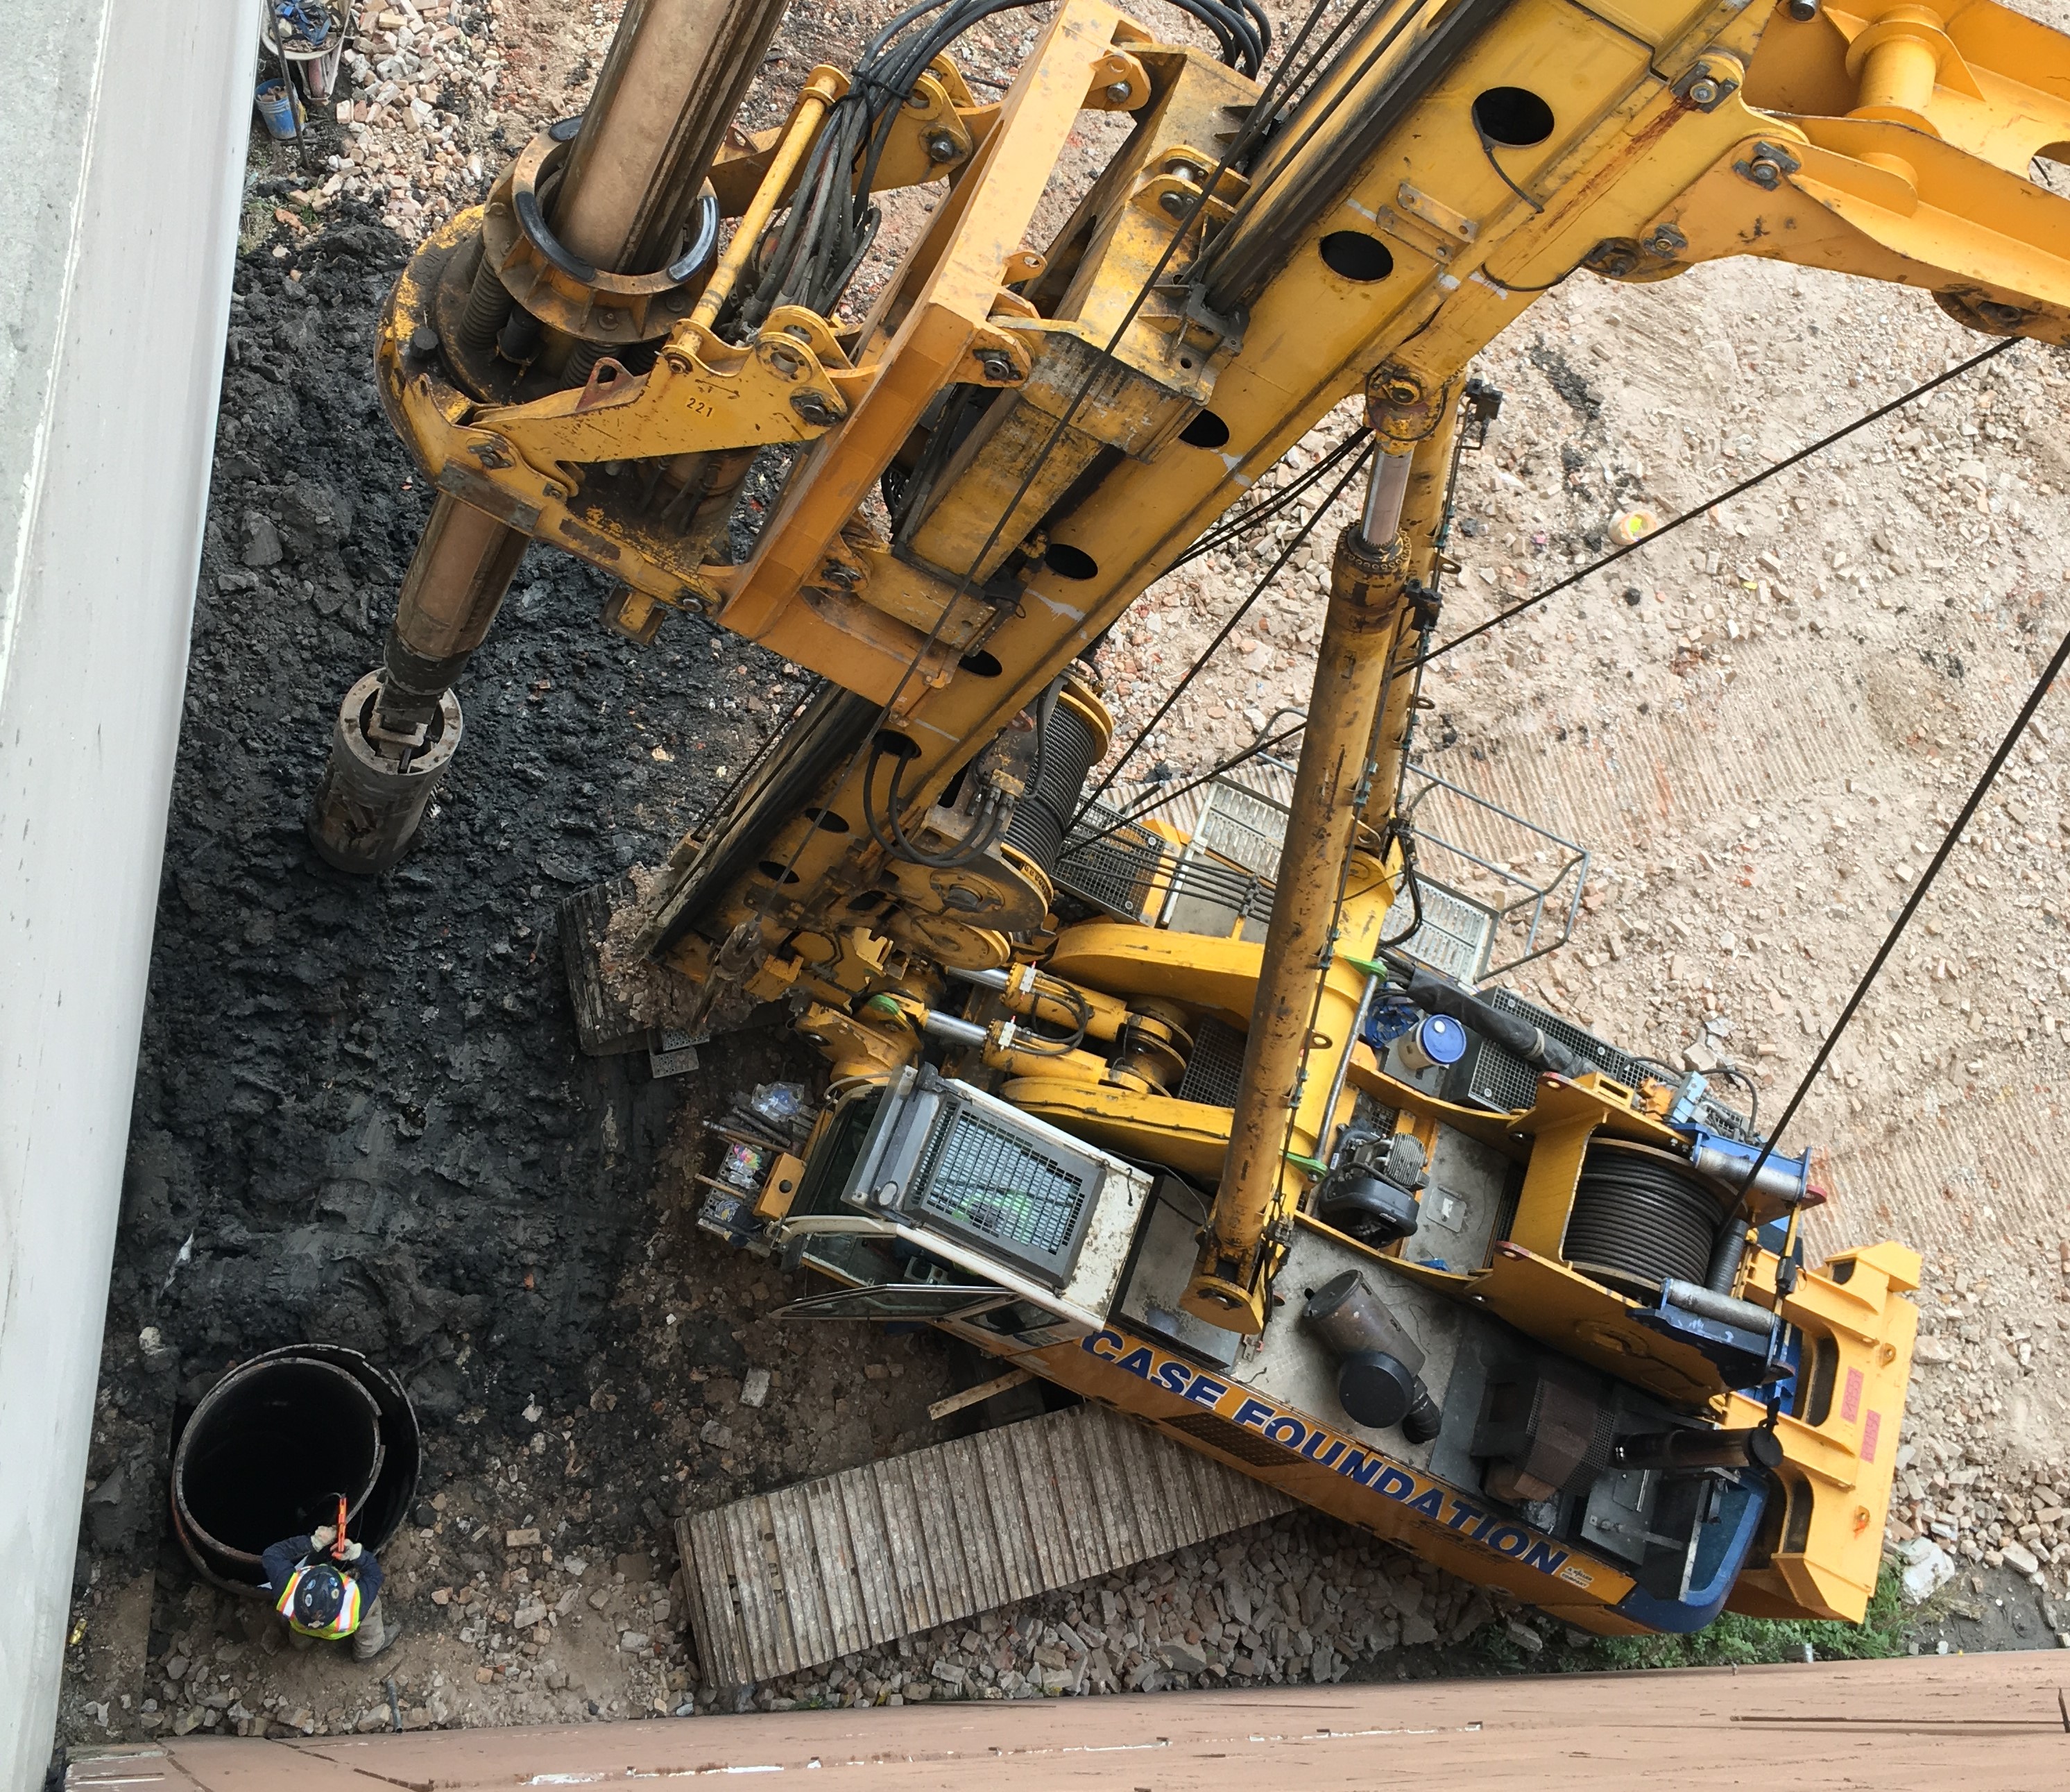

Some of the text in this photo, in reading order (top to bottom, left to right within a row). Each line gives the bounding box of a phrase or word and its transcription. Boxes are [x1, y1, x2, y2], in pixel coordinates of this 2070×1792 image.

[686, 397, 714, 418] 221
[1081, 1329, 1570, 1576] CASE FOUNDATION
